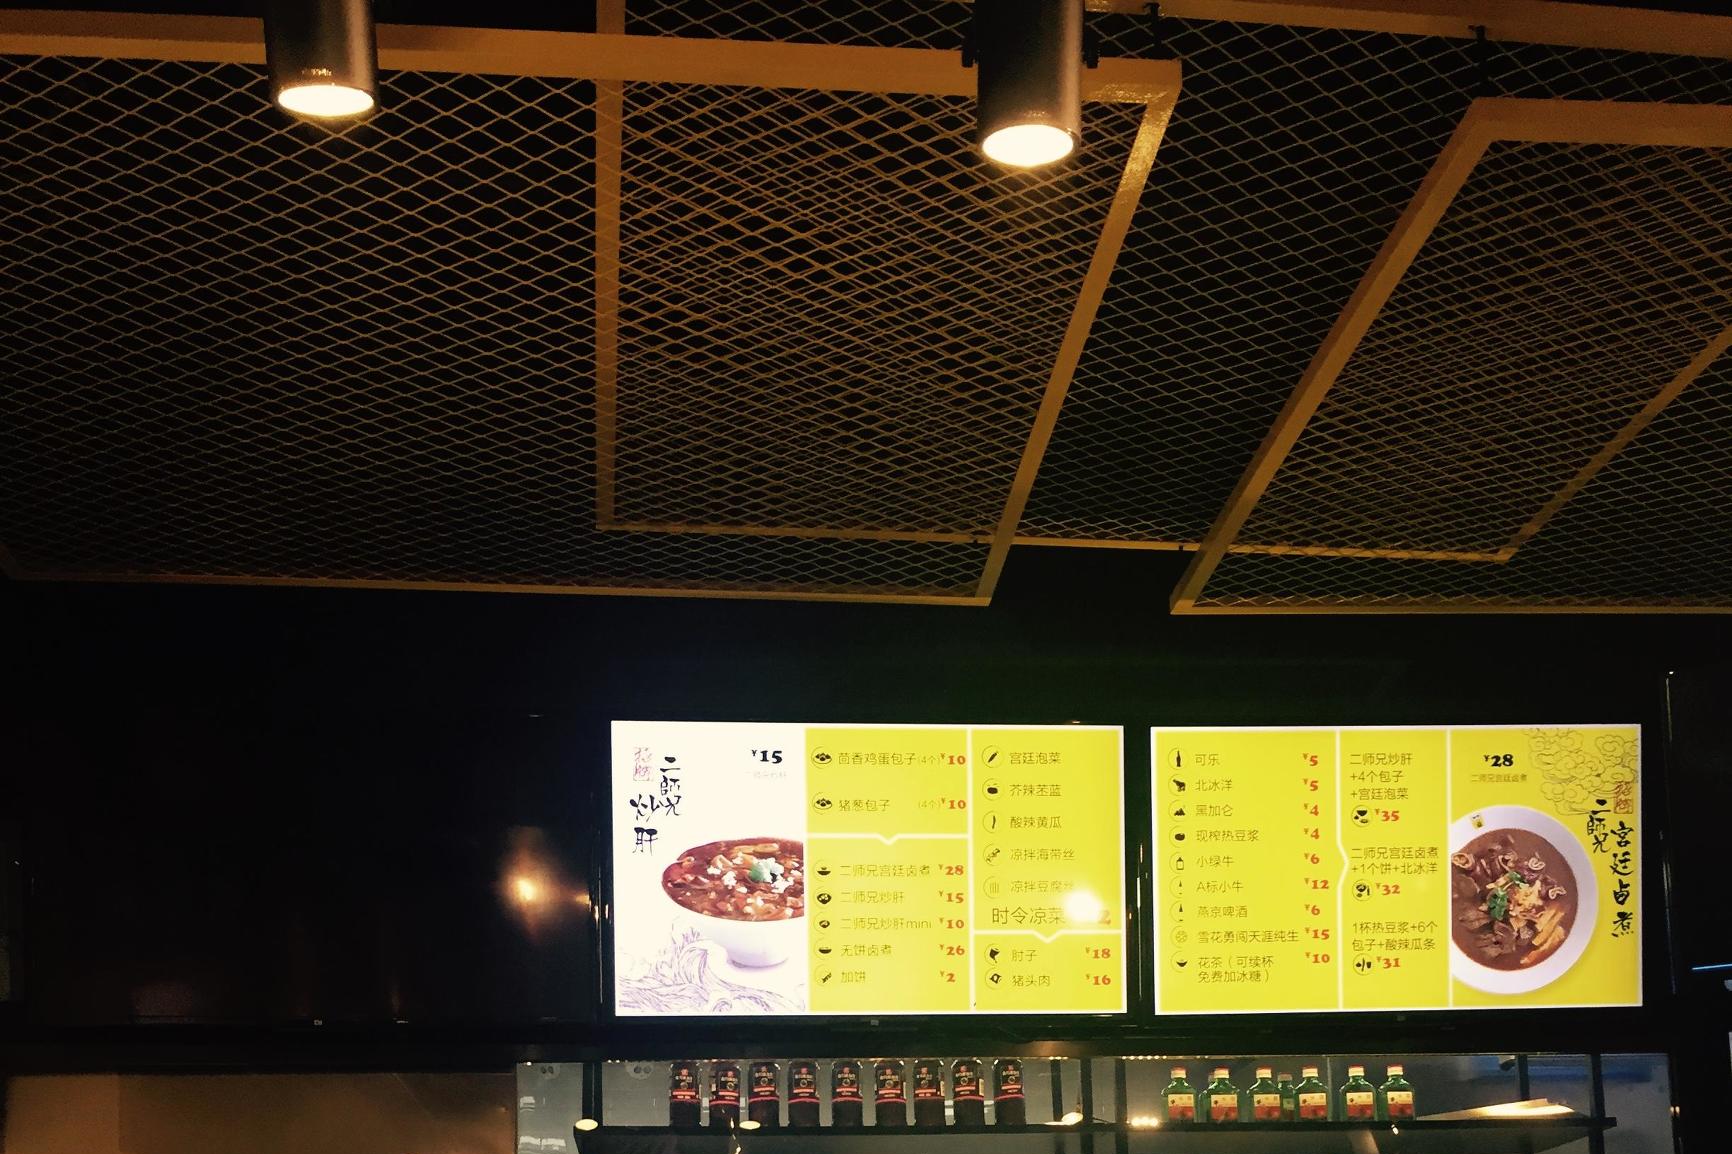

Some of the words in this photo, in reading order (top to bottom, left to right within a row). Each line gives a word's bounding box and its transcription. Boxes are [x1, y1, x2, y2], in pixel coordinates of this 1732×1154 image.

[751, 749, 784, 764] ¥15
[941, 752, 967, 766] ¥10
[1009, 751, 1062, 765] 宫廷泡菜
[1194, 753, 1221, 767] 可乐
[1302, 752, 1319, 767] ¥5
[1349, 752, 1413, 766] 二师兄炒肝
[1484, 753, 1514, 768] ¥28
[1349, 770, 1404, 784] +4个包子
[1194, 778, 1233, 792] 北冰洋
[1302, 777, 1319, 792] ¥5
[1350, 787, 1409, 801] +宫廷泡菜
[941, 797, 967, 811] ¥10
[1194, 804, 1234, 817] 黑加仑
[1303, 802, 1320, 817] ¥4
[1009, 815, 1062, 829] 酸辣黄瓜
[1374, 808, 1400, 822] ¥35
[1303, 827, 1320, 840] ¥4
[1010, 848, 1076, 862] 凉拌海带丝
[1196, 855, 1235, 868] 小绿牛
[1304, 852, 1320, 865] ¥6
[1351, 846, 1440, 860] 二师兄宫廷卤煮
[838, 865, 931, 878] 二师兄宫廷卤煮
[939, 863, 965, 877] ¥28
[1196, 880, 1244, 893] A标小牛
[1304, 877, 1330, 890] ¥12
[1375, 882, 1401, 896] ¥32
[838, 891, 905, 905] 二师兄炒肝
[939, 890, 965, 905] ¥15
[1197, 905, 1248, 919] 燕京啤酒
[1304, 903, 1321, 916] ¥6
[939, 917, 965, 931] ¥10
[1197, 930, 1299, 944] 雪花勇闯天涯纯生
[1305, 927, 1330, 941] ¥15
[840, 943, 893, 958] 无饼卤煮
[939, 943, 966, 957] ¥26
[1011, 949, 1038, 963] 肘子
[1085, 946, 1111, 960] ¥18
[1305, 951, 1331, 964] ¥10
[1375, 955, 1401, 969] ¥31
[840, 970, 867, 984] 加饼
[939, 970, 957, 984] ¥2
[1011, 974, 1051, 987] 猪头肉
[1085, 973, 1112, 986] ¥16
